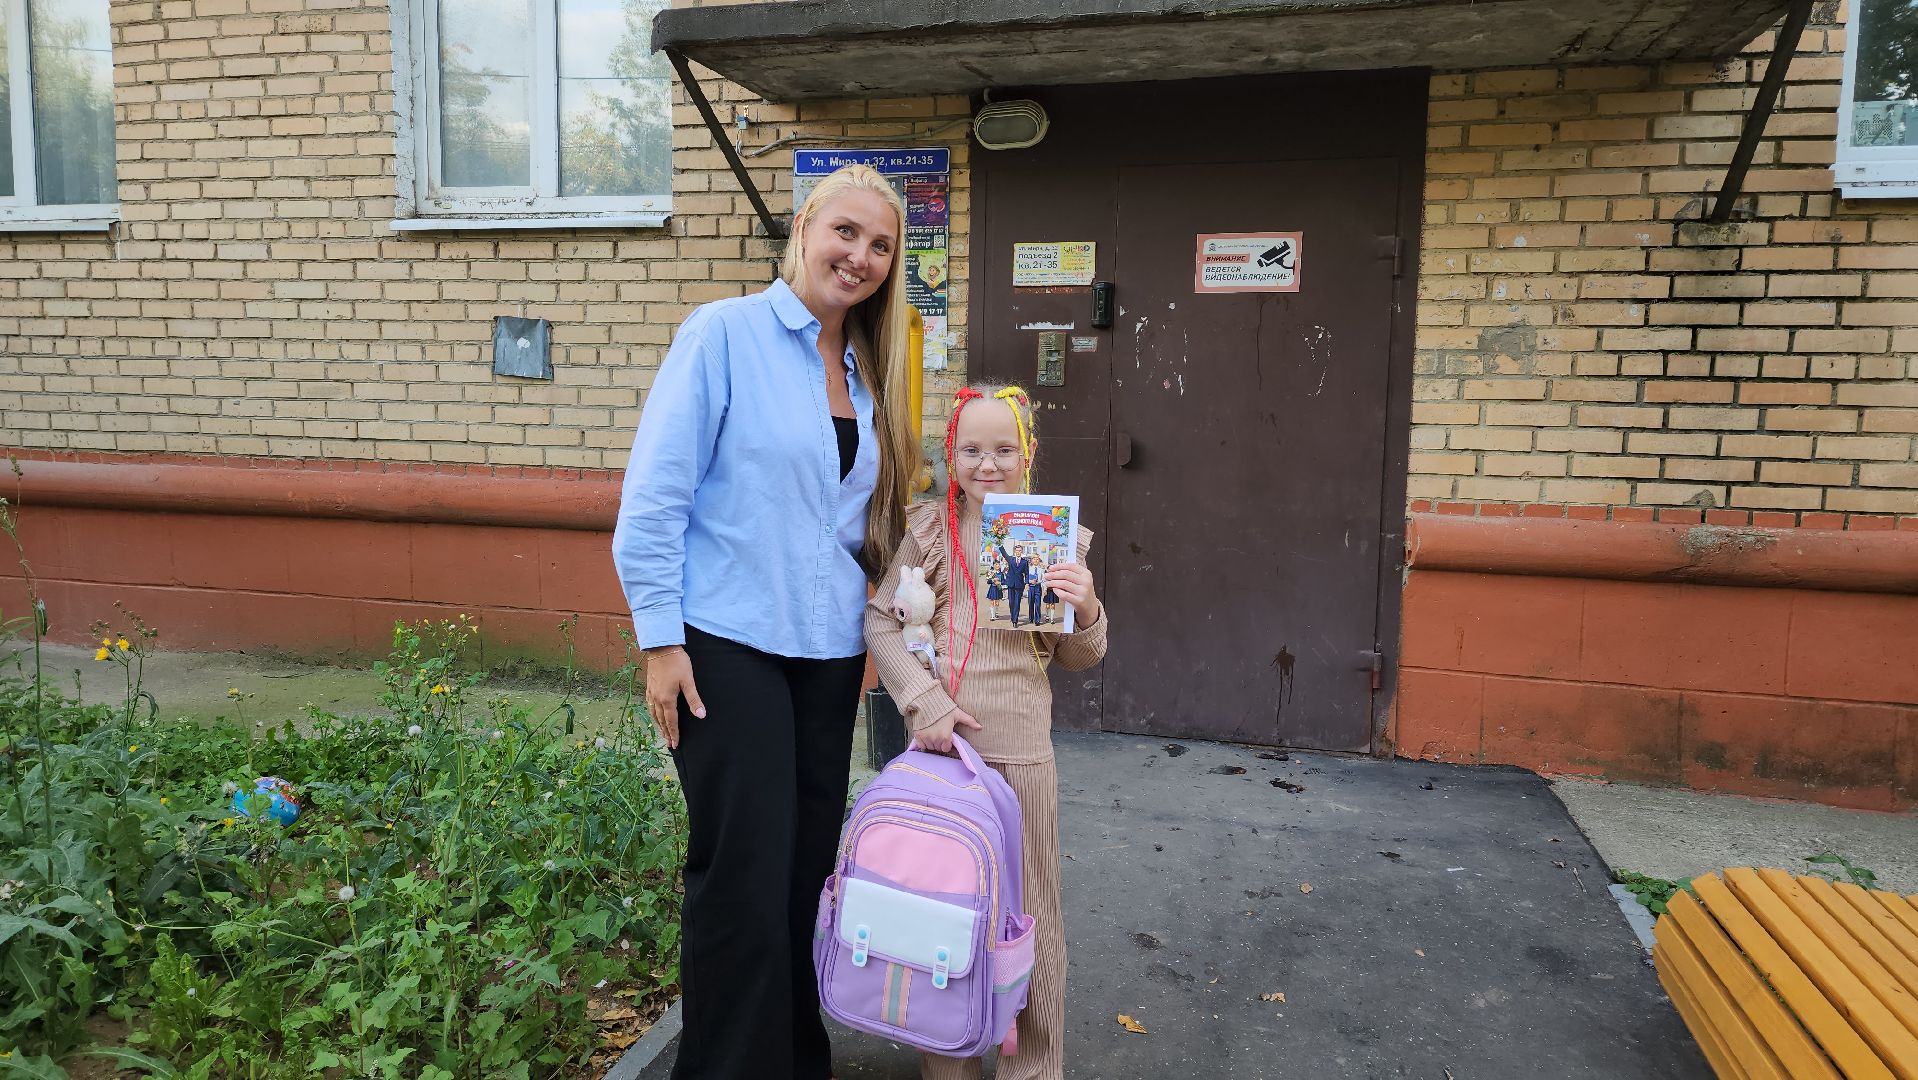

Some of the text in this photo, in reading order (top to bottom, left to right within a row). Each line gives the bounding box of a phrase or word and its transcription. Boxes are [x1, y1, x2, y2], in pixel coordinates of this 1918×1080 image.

[811, 157, 827, 167] Ул.
[890, 156, 933, 166] кв.21-35
[1053, 251, 1058, 259] 2
[1205, 273, 1290, 281] ВИДЕОНАБЛЮДЕНИЕ!
